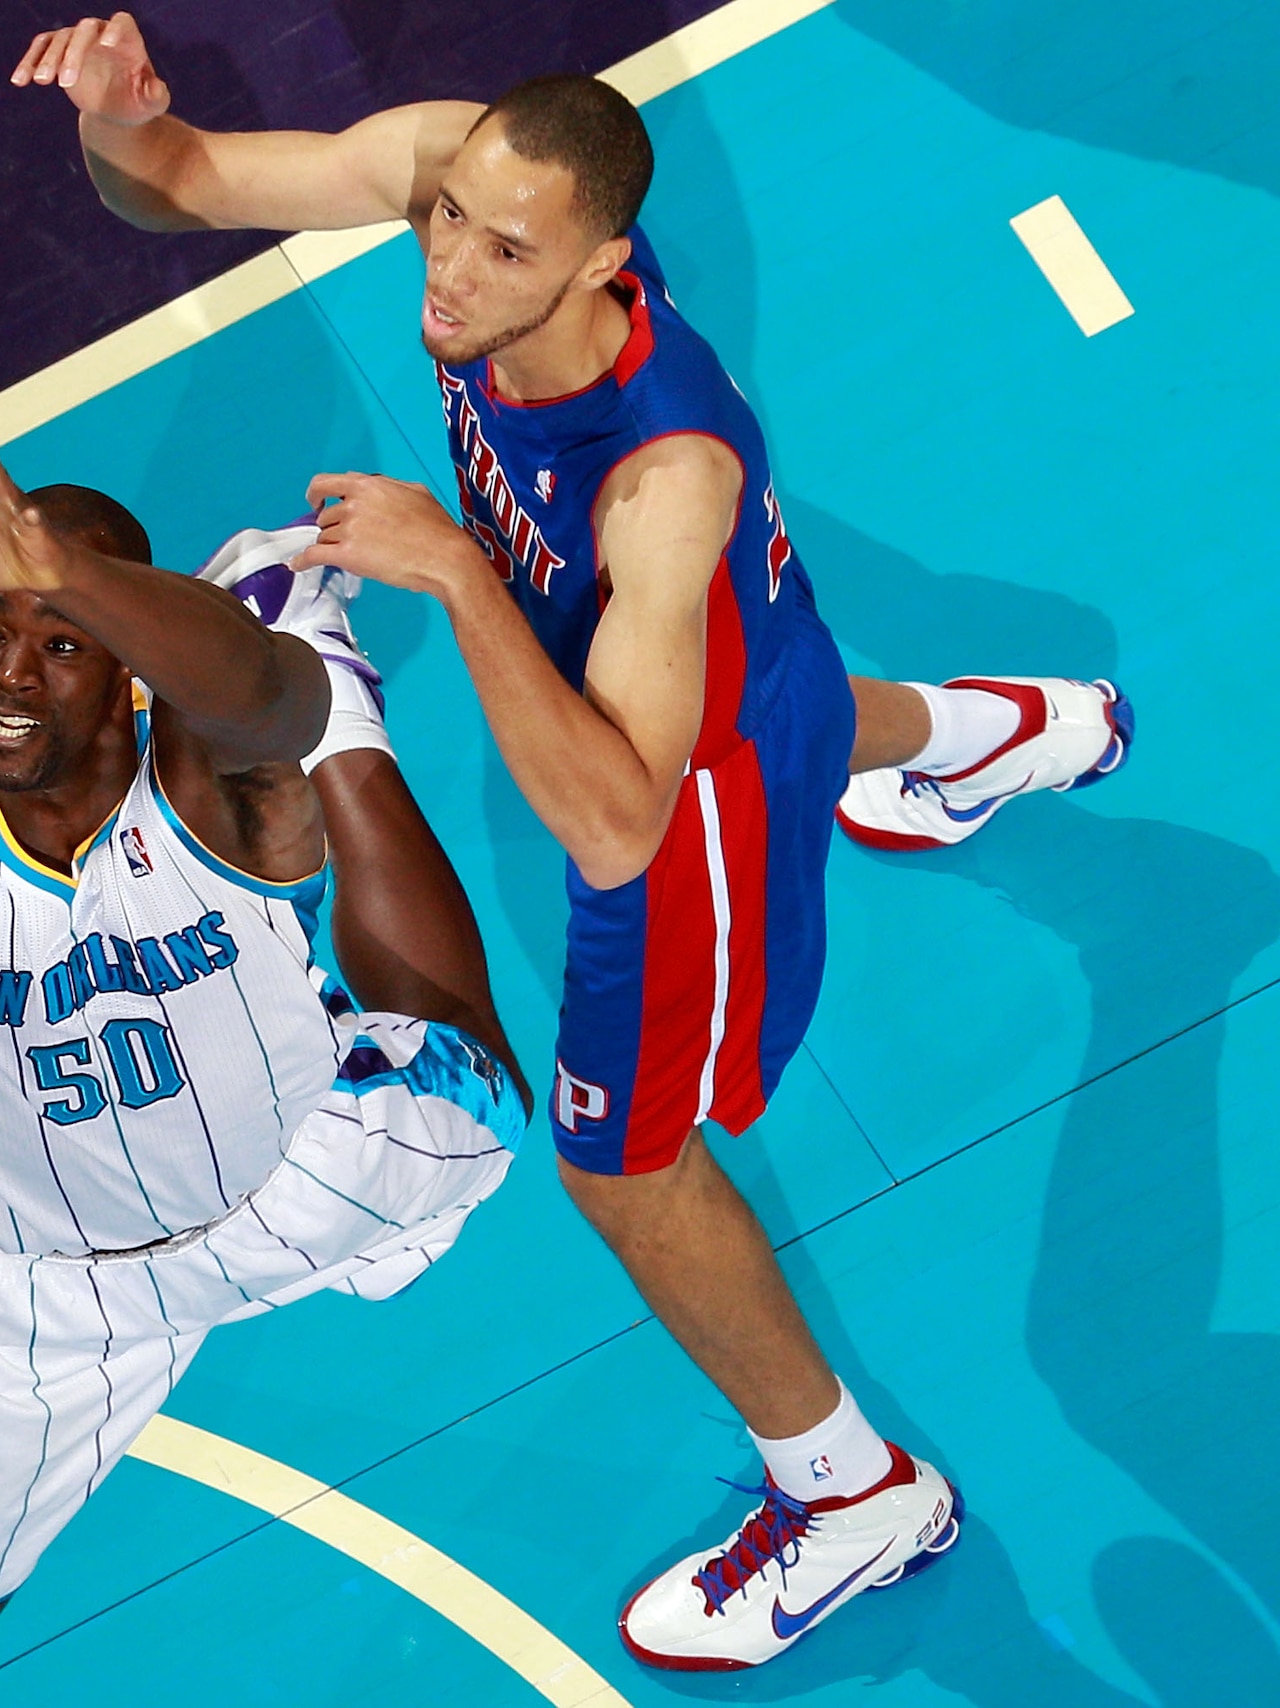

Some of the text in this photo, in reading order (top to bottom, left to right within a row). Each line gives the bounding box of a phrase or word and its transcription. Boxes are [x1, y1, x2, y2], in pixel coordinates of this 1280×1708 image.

[41, 910, 240, 1025] ORLEANS
[26, 1017, 187, 1127] 50
[555, 1056, 611, 1135] P
